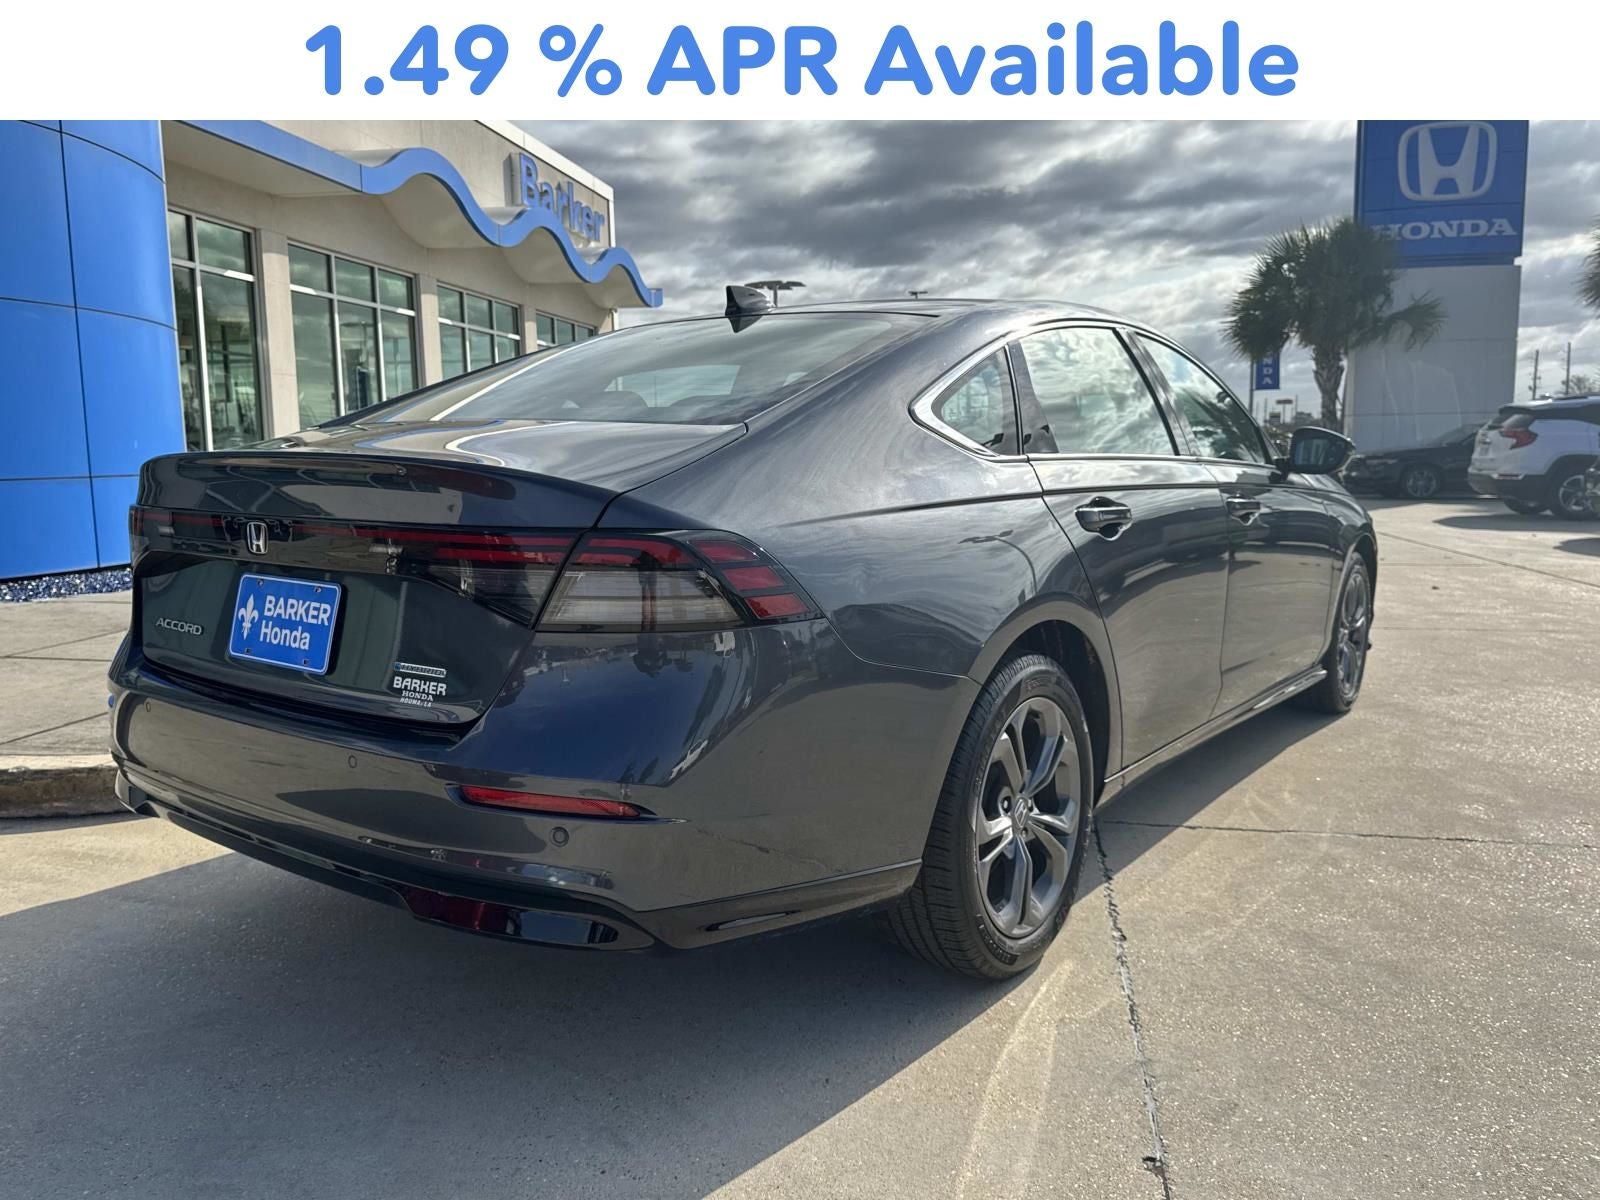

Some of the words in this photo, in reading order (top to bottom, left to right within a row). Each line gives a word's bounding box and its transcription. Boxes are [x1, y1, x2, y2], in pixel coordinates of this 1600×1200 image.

[519, 152, 605, 242] Barker
[1370, 218, 1518, 241] HONDA
[264, 595, 331, 626] BARKER
[155, 617, 202, 635] ACCORD
[259, 620, 311, 650] Honda
[393, 676, 447, 696] BARKER
[402, 690, 434, 702] HONDA
